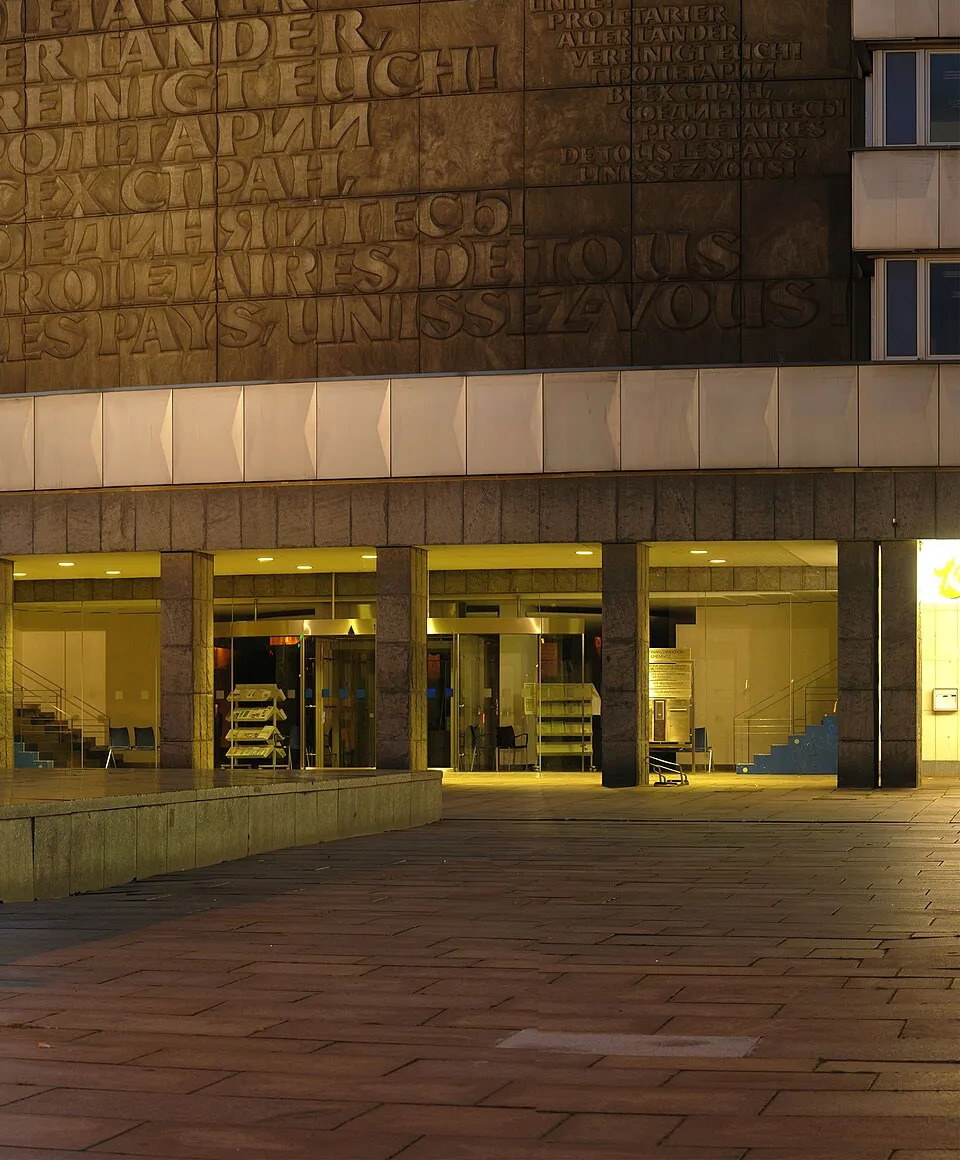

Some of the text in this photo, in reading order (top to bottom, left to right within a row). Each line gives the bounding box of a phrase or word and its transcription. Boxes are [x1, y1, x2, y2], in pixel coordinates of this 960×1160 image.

[547, 4, 728, 31] PROLETARIER
[558, 27, 631, 50] ALLER
[567, 40, 804, 69] VEREINIGT EUCH!
[277, 46, 498, 106] EUCH!
[592, 61, 777, 87] ПРОЛЕТАРИИ
[608, 82, 775, 105] ВСЕХ СТРАН,
[642, 120, 828, 142] PROLETAIRES
[560, 139, 807, 165] DE TOUS LES PAYS,
[122, 151, 358, 212] СТРАН,
[435, 240, 508, 289] DE
[526, 228, 743, 283] TOUS
[98, 300, 277, 357] PAYS,
